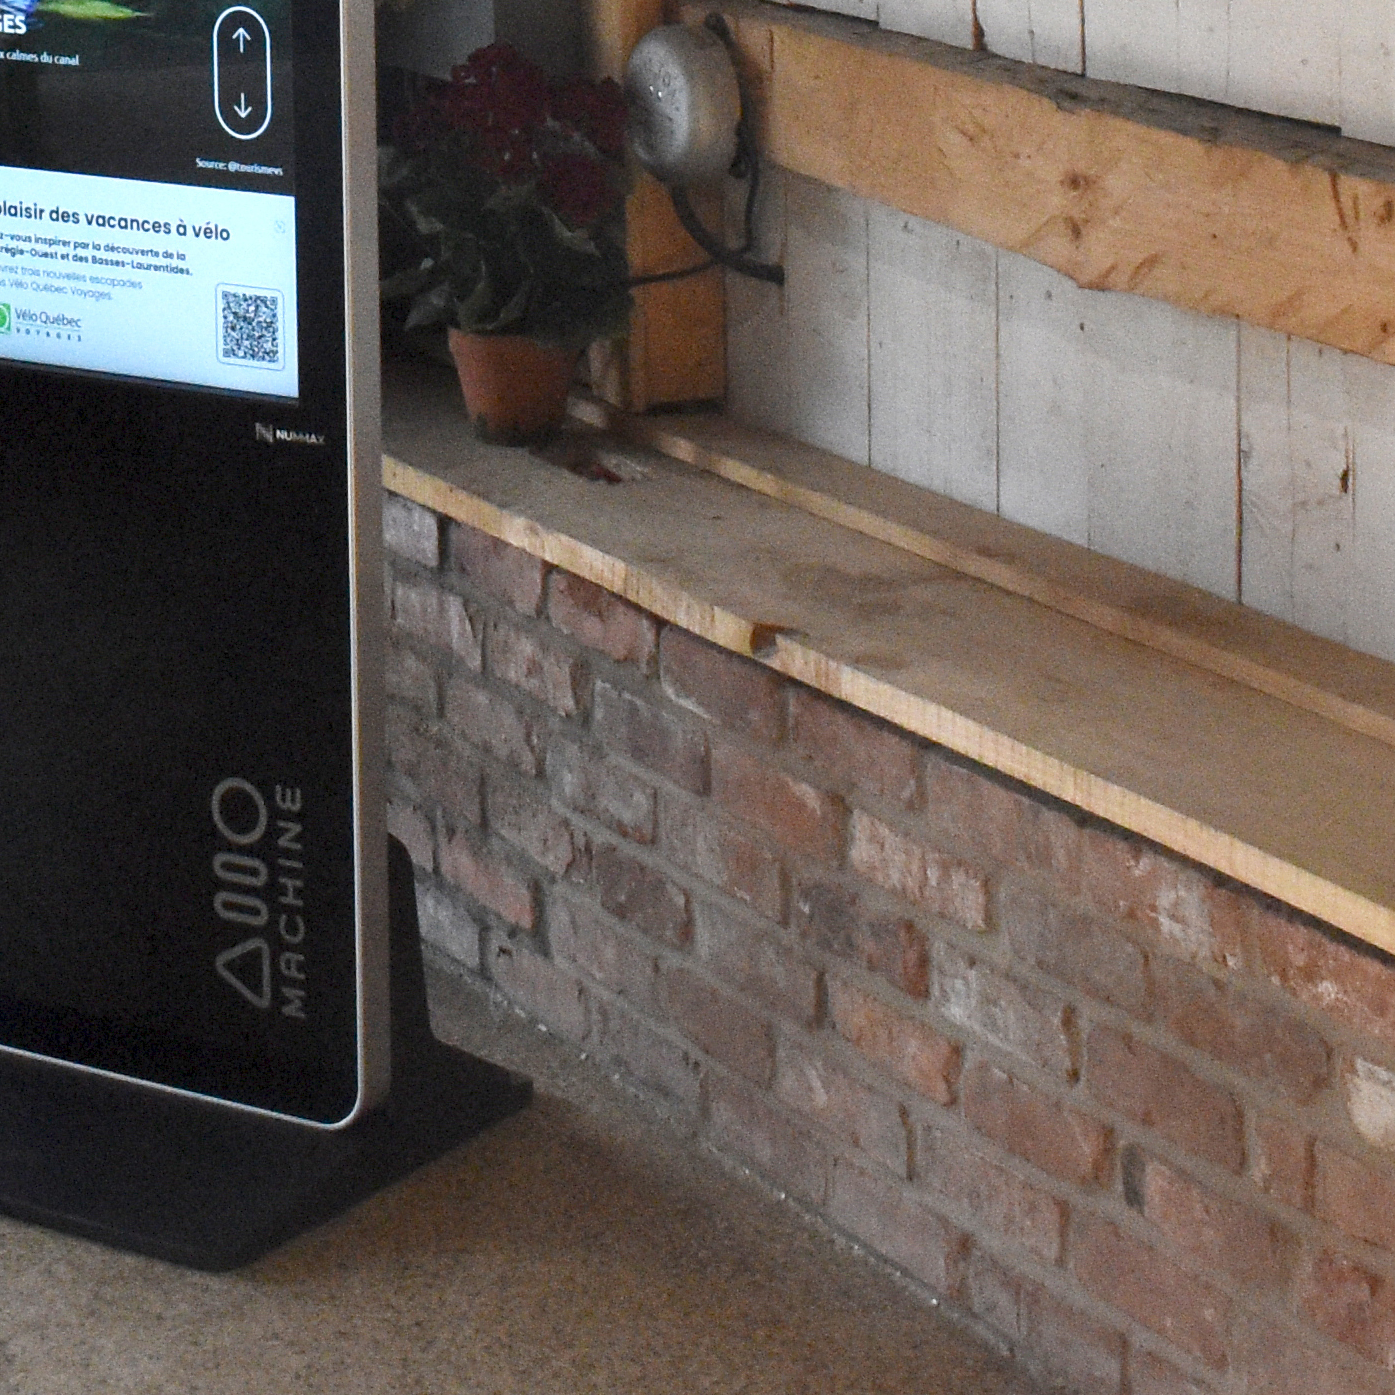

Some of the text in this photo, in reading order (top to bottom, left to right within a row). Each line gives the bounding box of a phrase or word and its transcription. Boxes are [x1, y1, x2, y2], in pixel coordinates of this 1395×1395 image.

[6, 49, 38, 62] calmes
[40, 51, 53, 64] du
[54, 54, 80, 66] canal
[49, 205, 80, 224] des
[84, 212, 172, 235] vacances
[176, 217, 187, 236] à
[192, 221, 231, 241] vélo
[34, 233, 71, 248] inspirer
[73, 240, 90, 251] par
[92, 241, 101, 251] la
[103, 243, 160, 258] découverte
[161, 249, 174, 260] de
[176, 250, 186, 261] la
[60, 252, 70, 261] et
[72, 253, 89, 264] des
[91, 255, 193, 276] Basses-Laurentides.
[8, 278, 28, 290] Vélo
[30, 281, 68, 294] Québec
[21, 265, 41, 277] trois
[42, 268, 87, 283] nouvelles
[89, 275, 143, 290] escapades
[15, 307, 82, 328] Vélo Québec
[275, 784, 305, 1018] MACHINE
